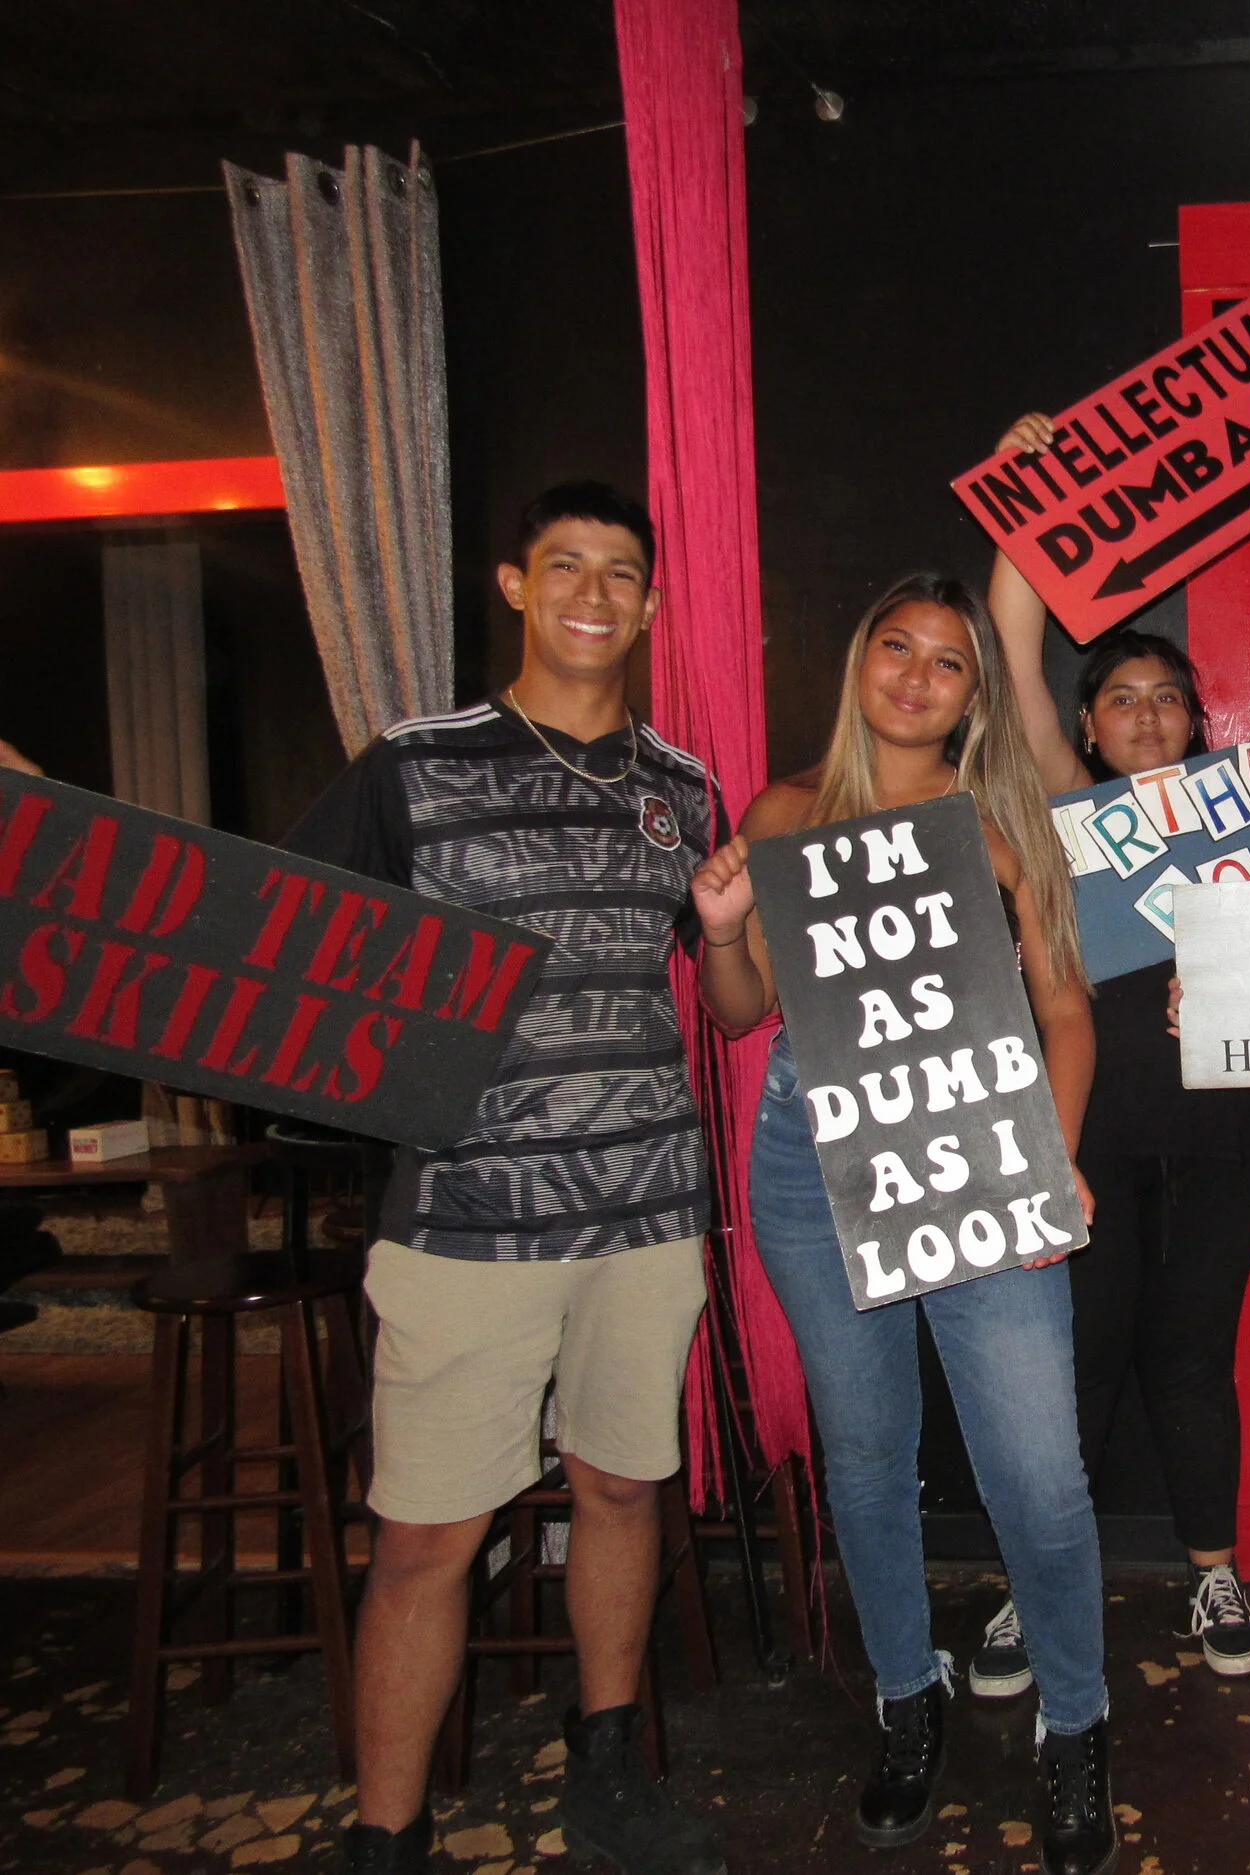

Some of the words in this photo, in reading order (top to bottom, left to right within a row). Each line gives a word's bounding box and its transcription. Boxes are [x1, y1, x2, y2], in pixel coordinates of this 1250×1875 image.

[802, 821, 930, 899] I'M
[242, 866, 536, 1032] TEAM
[806, 891, 959, 978] NOT
[0, 920, 404, 1103] SKILLS
[858, 974, 954, 1049] AS
[806, 1035, 1039, 1144] DUMB
[869, 1134, 970, 1213] AS
[991, 1119, 1029, 1176] I
[856, 1191, 1073, 1299] LOOK
